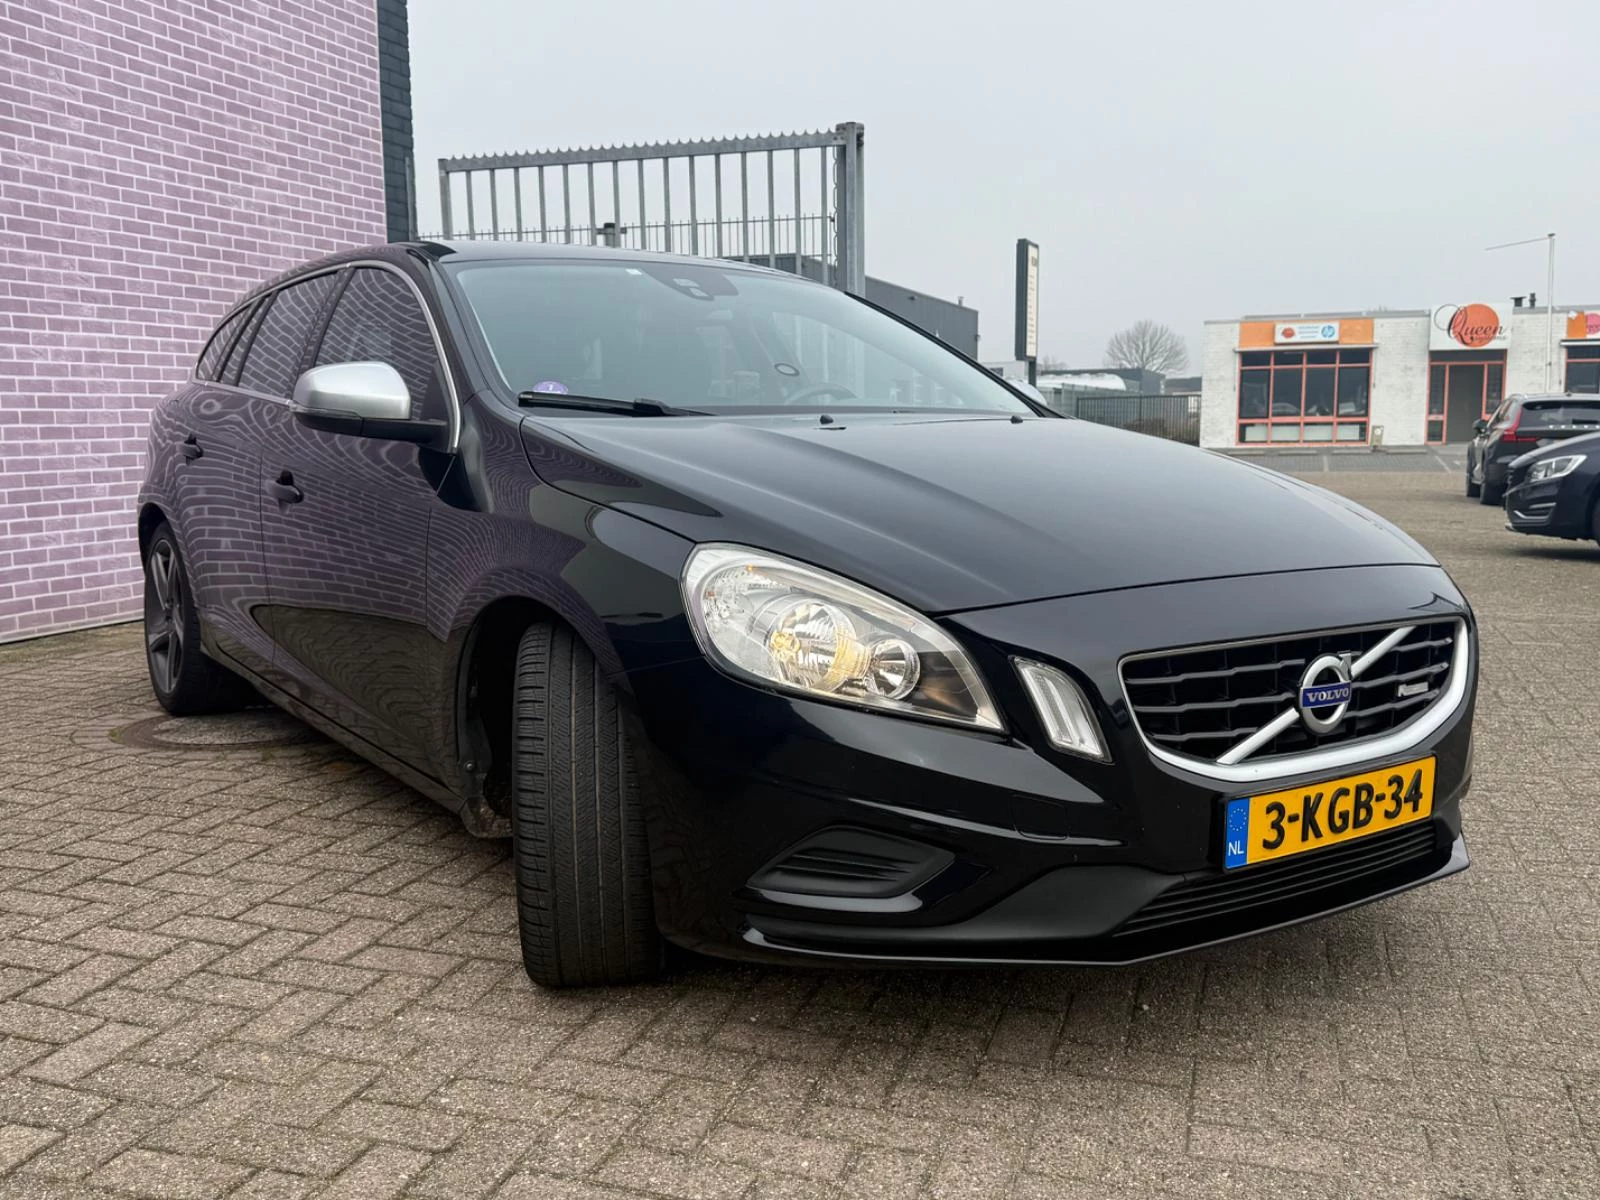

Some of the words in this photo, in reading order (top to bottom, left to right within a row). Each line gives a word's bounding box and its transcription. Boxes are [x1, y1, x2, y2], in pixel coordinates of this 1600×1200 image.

[1434, 304, 1505, 345] Queen
[1306, 687, 1350, 702] VOLVO
[1262, 768, 1423, 850] 3-KGB-34
[1228, 840, 1245, 856] NL
